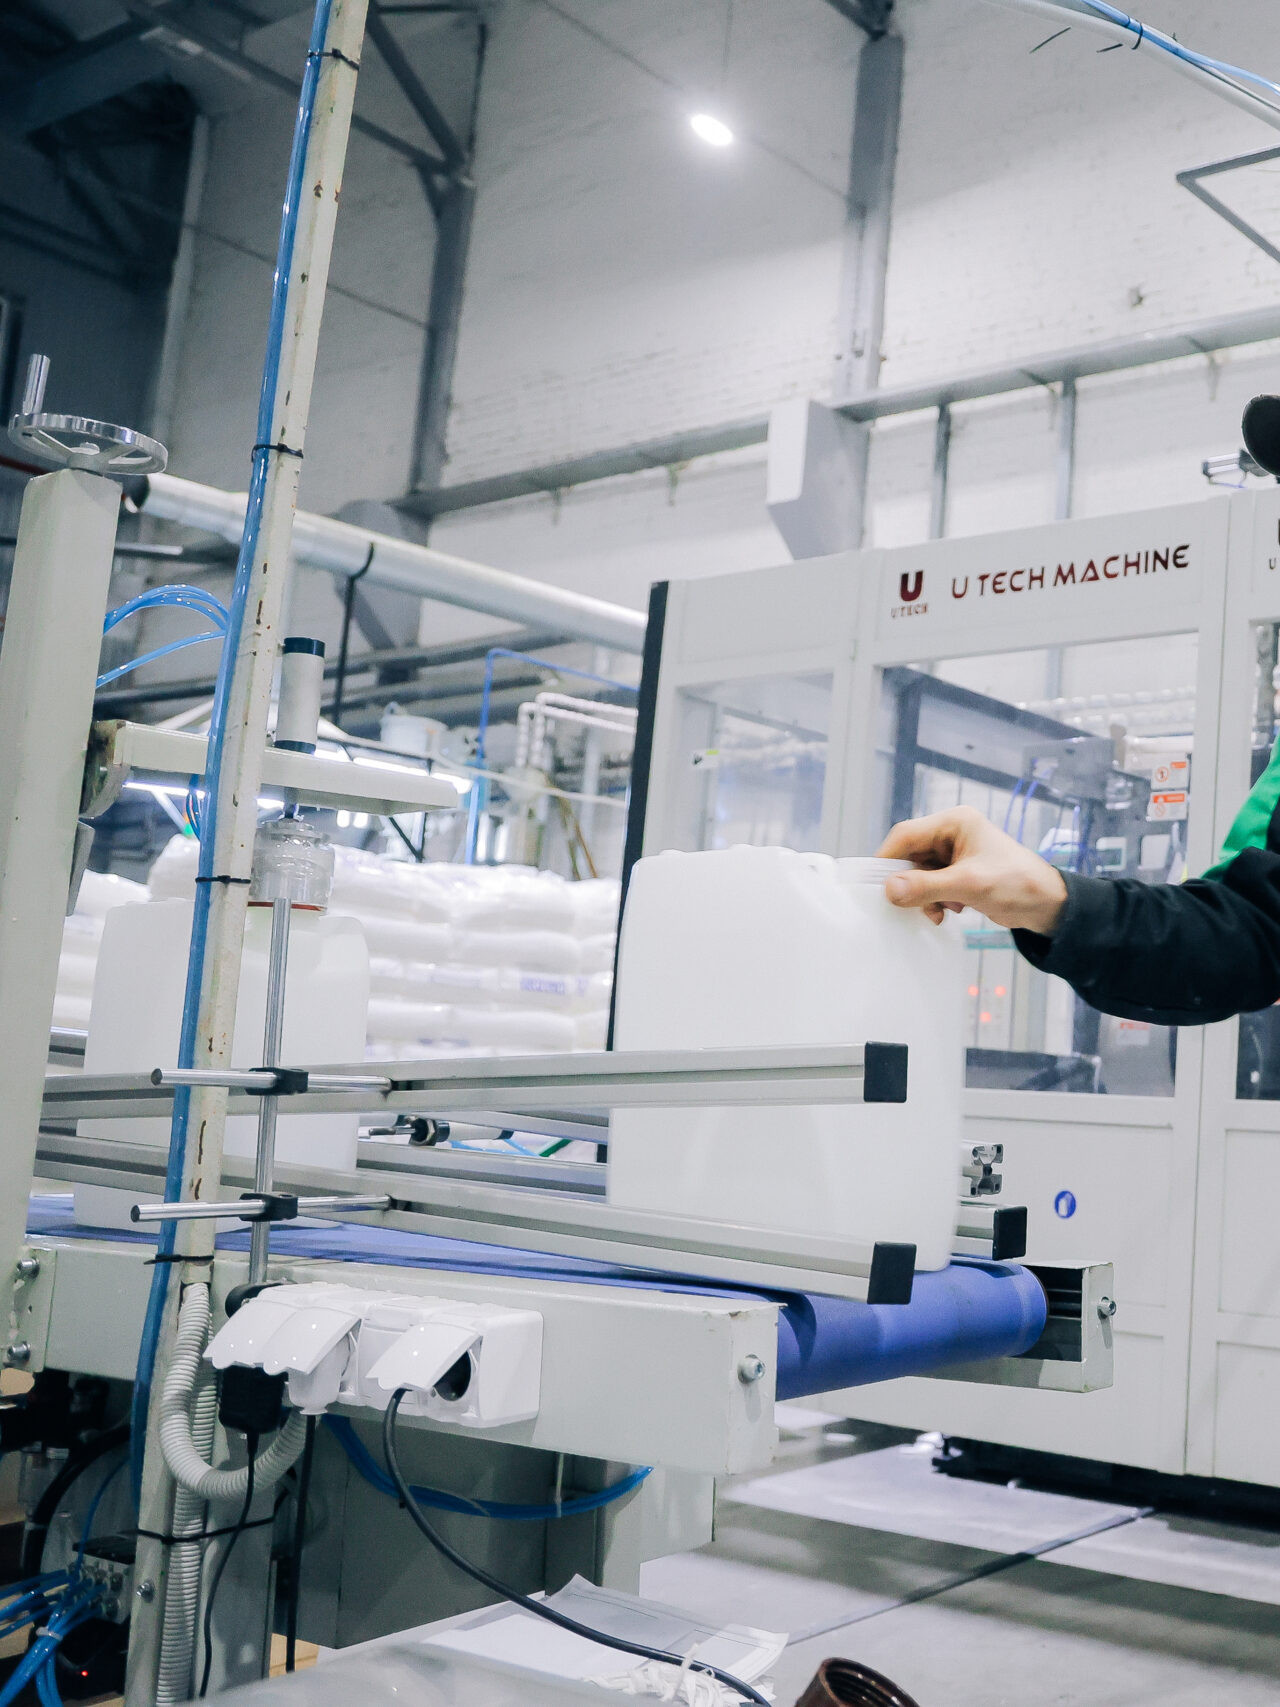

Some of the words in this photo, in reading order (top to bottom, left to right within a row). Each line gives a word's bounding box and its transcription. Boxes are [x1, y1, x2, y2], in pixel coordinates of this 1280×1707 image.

[900, 570, 923, 602] U
[952, 576, 968, 599] U
[978, 566, 1045, 596] TECH
[1053, 544, 1190, 586] MACHINE
